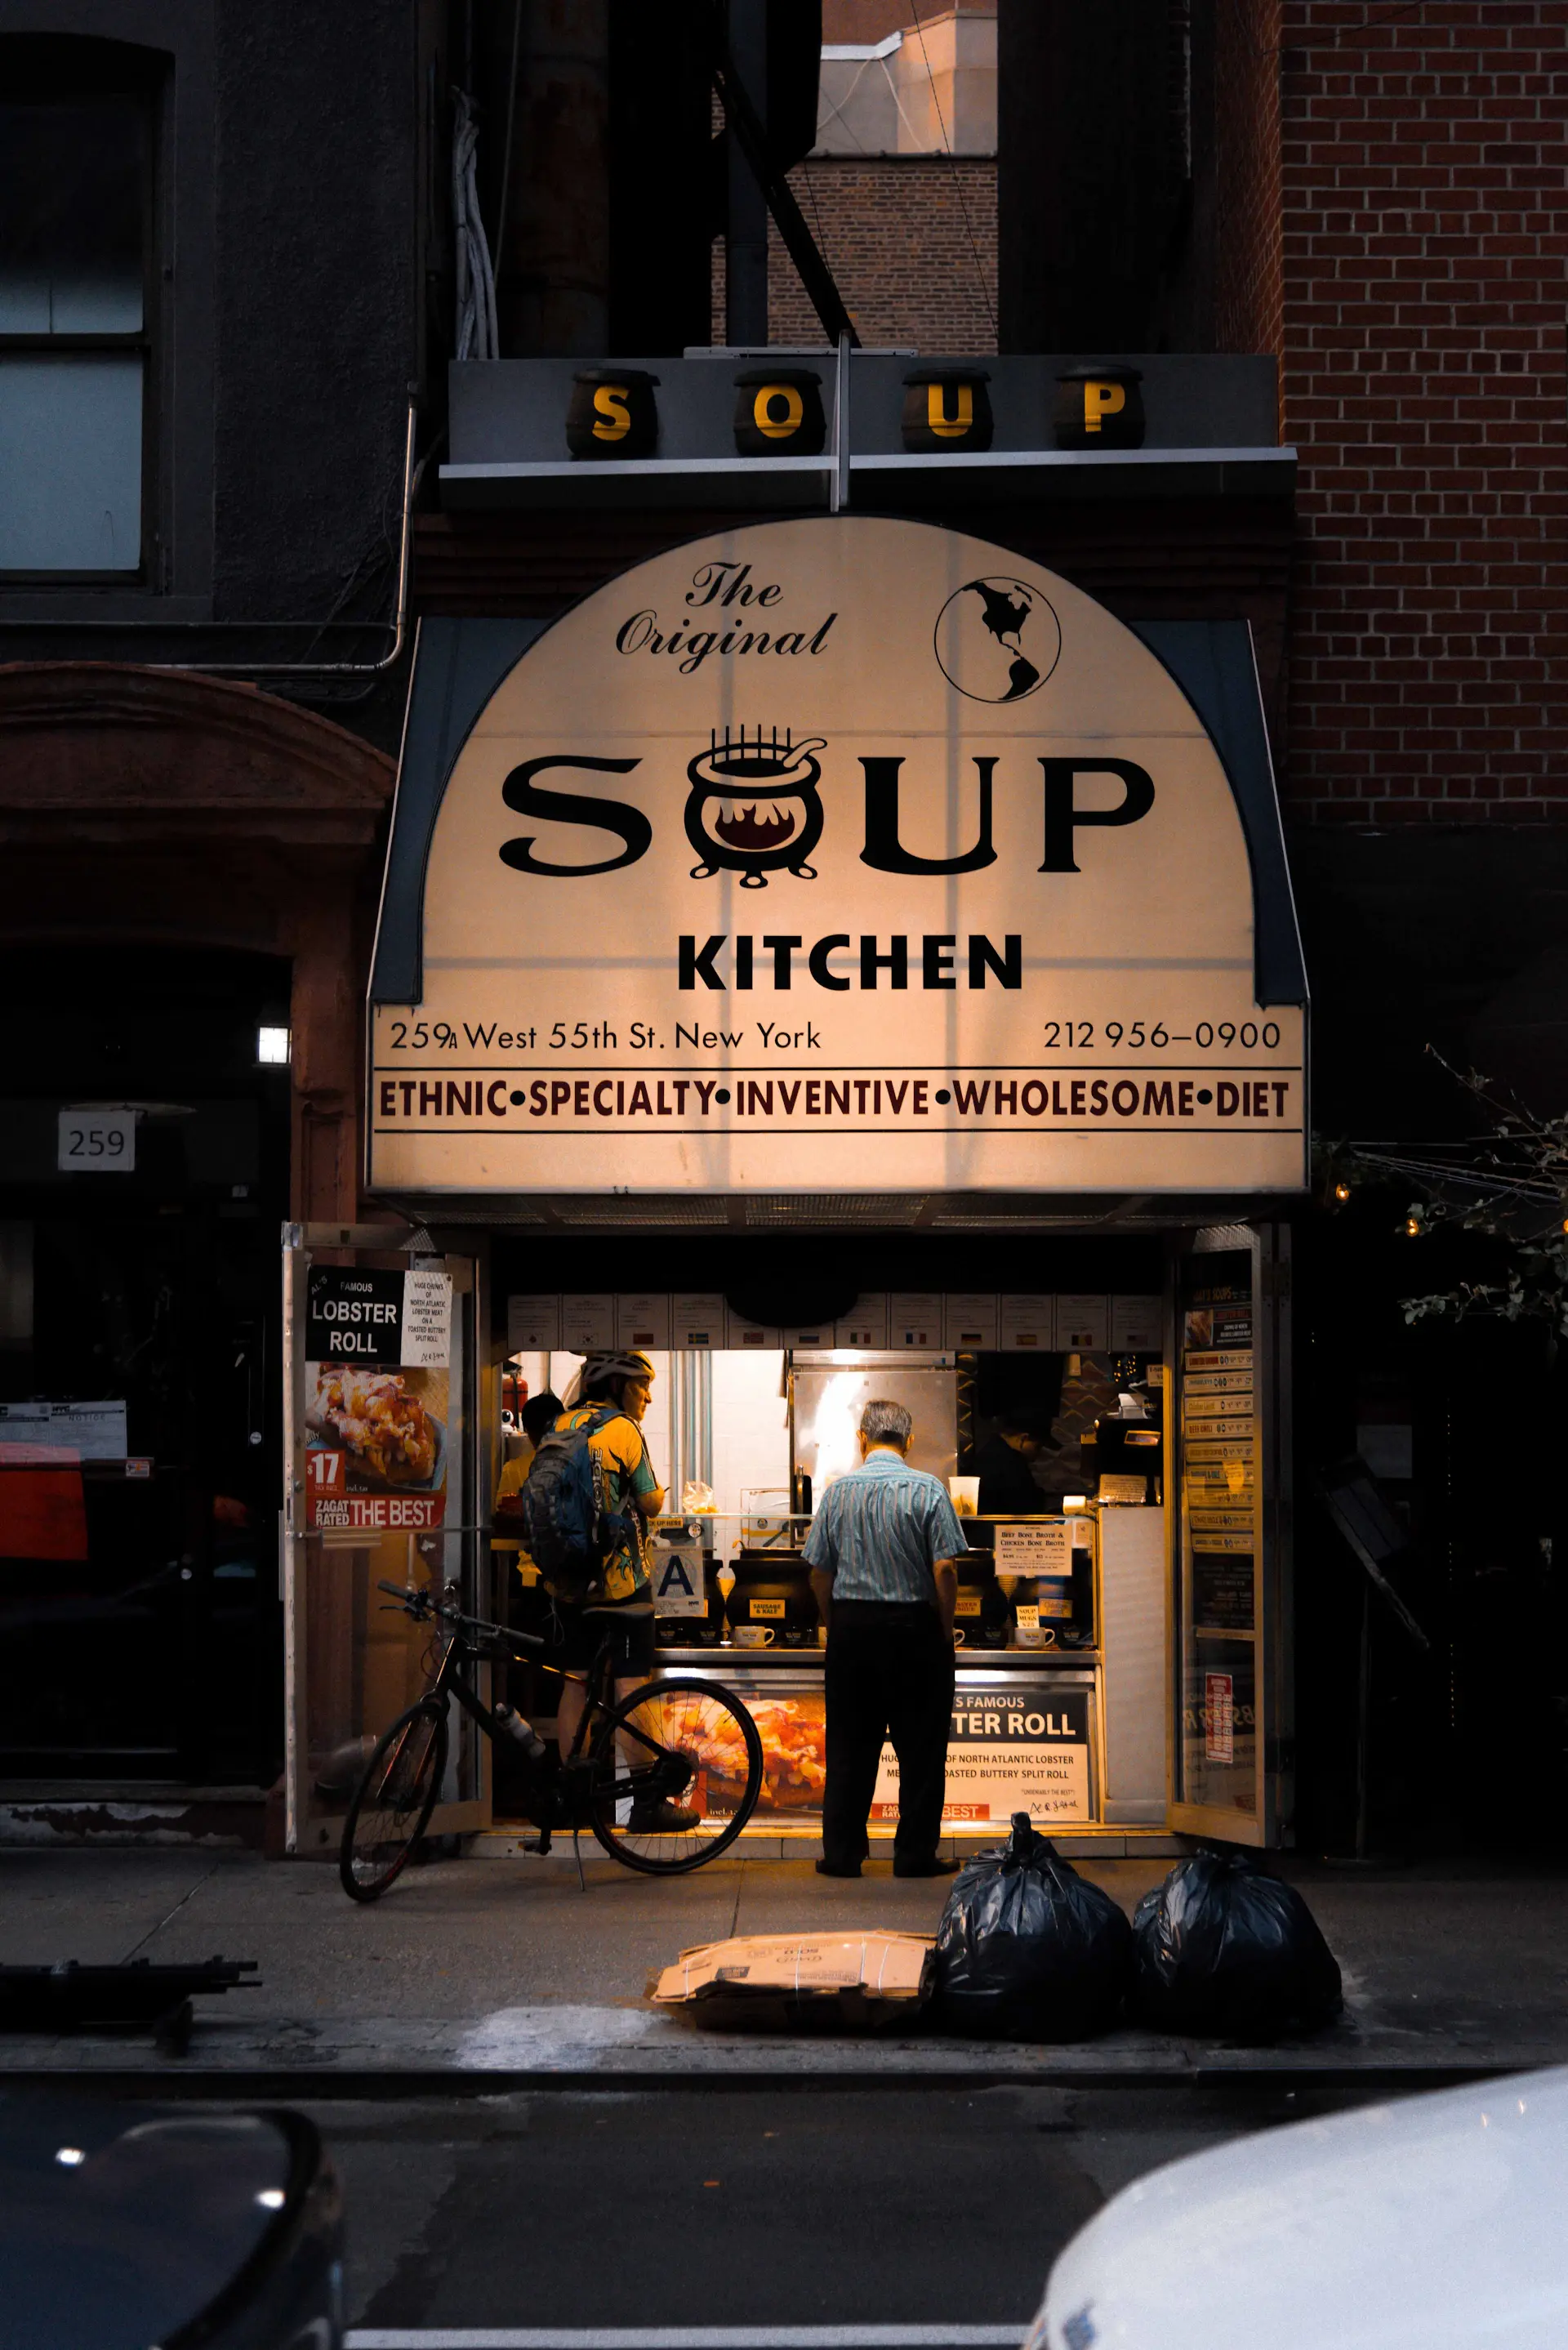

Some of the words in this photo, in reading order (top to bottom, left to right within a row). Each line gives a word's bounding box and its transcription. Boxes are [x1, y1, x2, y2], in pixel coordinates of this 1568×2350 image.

[684, 562, 783, 609] The
[615, 609, 838, 675] Original
[679, 934, 1022, 991] KITCHEN
[463, 1022, 537, 1049] West
[550, 1022, 617, 1049] 55th
[629, 1022, 665, 1049] St.
[675, 1022, 743, 1049] New
[757, 1022, 822, 1049] York
[1044, 1022, 1094, 1048] 212
[380, 1080, 507, 1117] ETHNIC
[528, 1080, 718, 1117] SPECIALTY
[737, 1080, 929, 1116] INVENTIVE
[952, 1079, 1195, 1117] WHOLESOME
[1216, 1081, 1290, 1117] DIET
[68, 1130, 126, 1157] 259
[340, 1281, 373, 1293] FAMOUS
[414, 1282, 426, 1290] HUGE
[312, 1300, 398, 1325] LOBSTER
[410, 1299, 425, 1307] NORTH
[425, 1299, 446, 1308] ATLANTIC
[412, 1308, 431, 1316] LOBSTER
[408, 1325, 427, 1334] TOASTED
[329, 1331, 378, 1353] ROLL
[315, 1500, 350, 1513] ZAGAT
[350, 1500, 386, 1526] THE
[390, 1500, 434, 1526] BEST
[315, 1513, 350, 1527] RATED
[657, 1555, 694, 1597] A
[967, 1697, 1025, 1709] FAMOUS
[951, 1712, 1001, 1735] TER
[1008, 1713, 1076, 1736] ROLL
[945, 1755, 957, 1764] OF
[959, 1755, 989, 1764] NORTH
[991, 1755, 1036, 1764] ATLANTIC
[1036, 1755, 1074, 1764] LOBSTER
[944, 1768, 977, 1778] OASTED
[980, 1769, 1019, 1778] BUTTERY
[1022, 1769, 1045, 1779] SPLIT
[1047, 1770, 1069, 1779] ROLL
[942, 1806, 979, 1820] BEST
